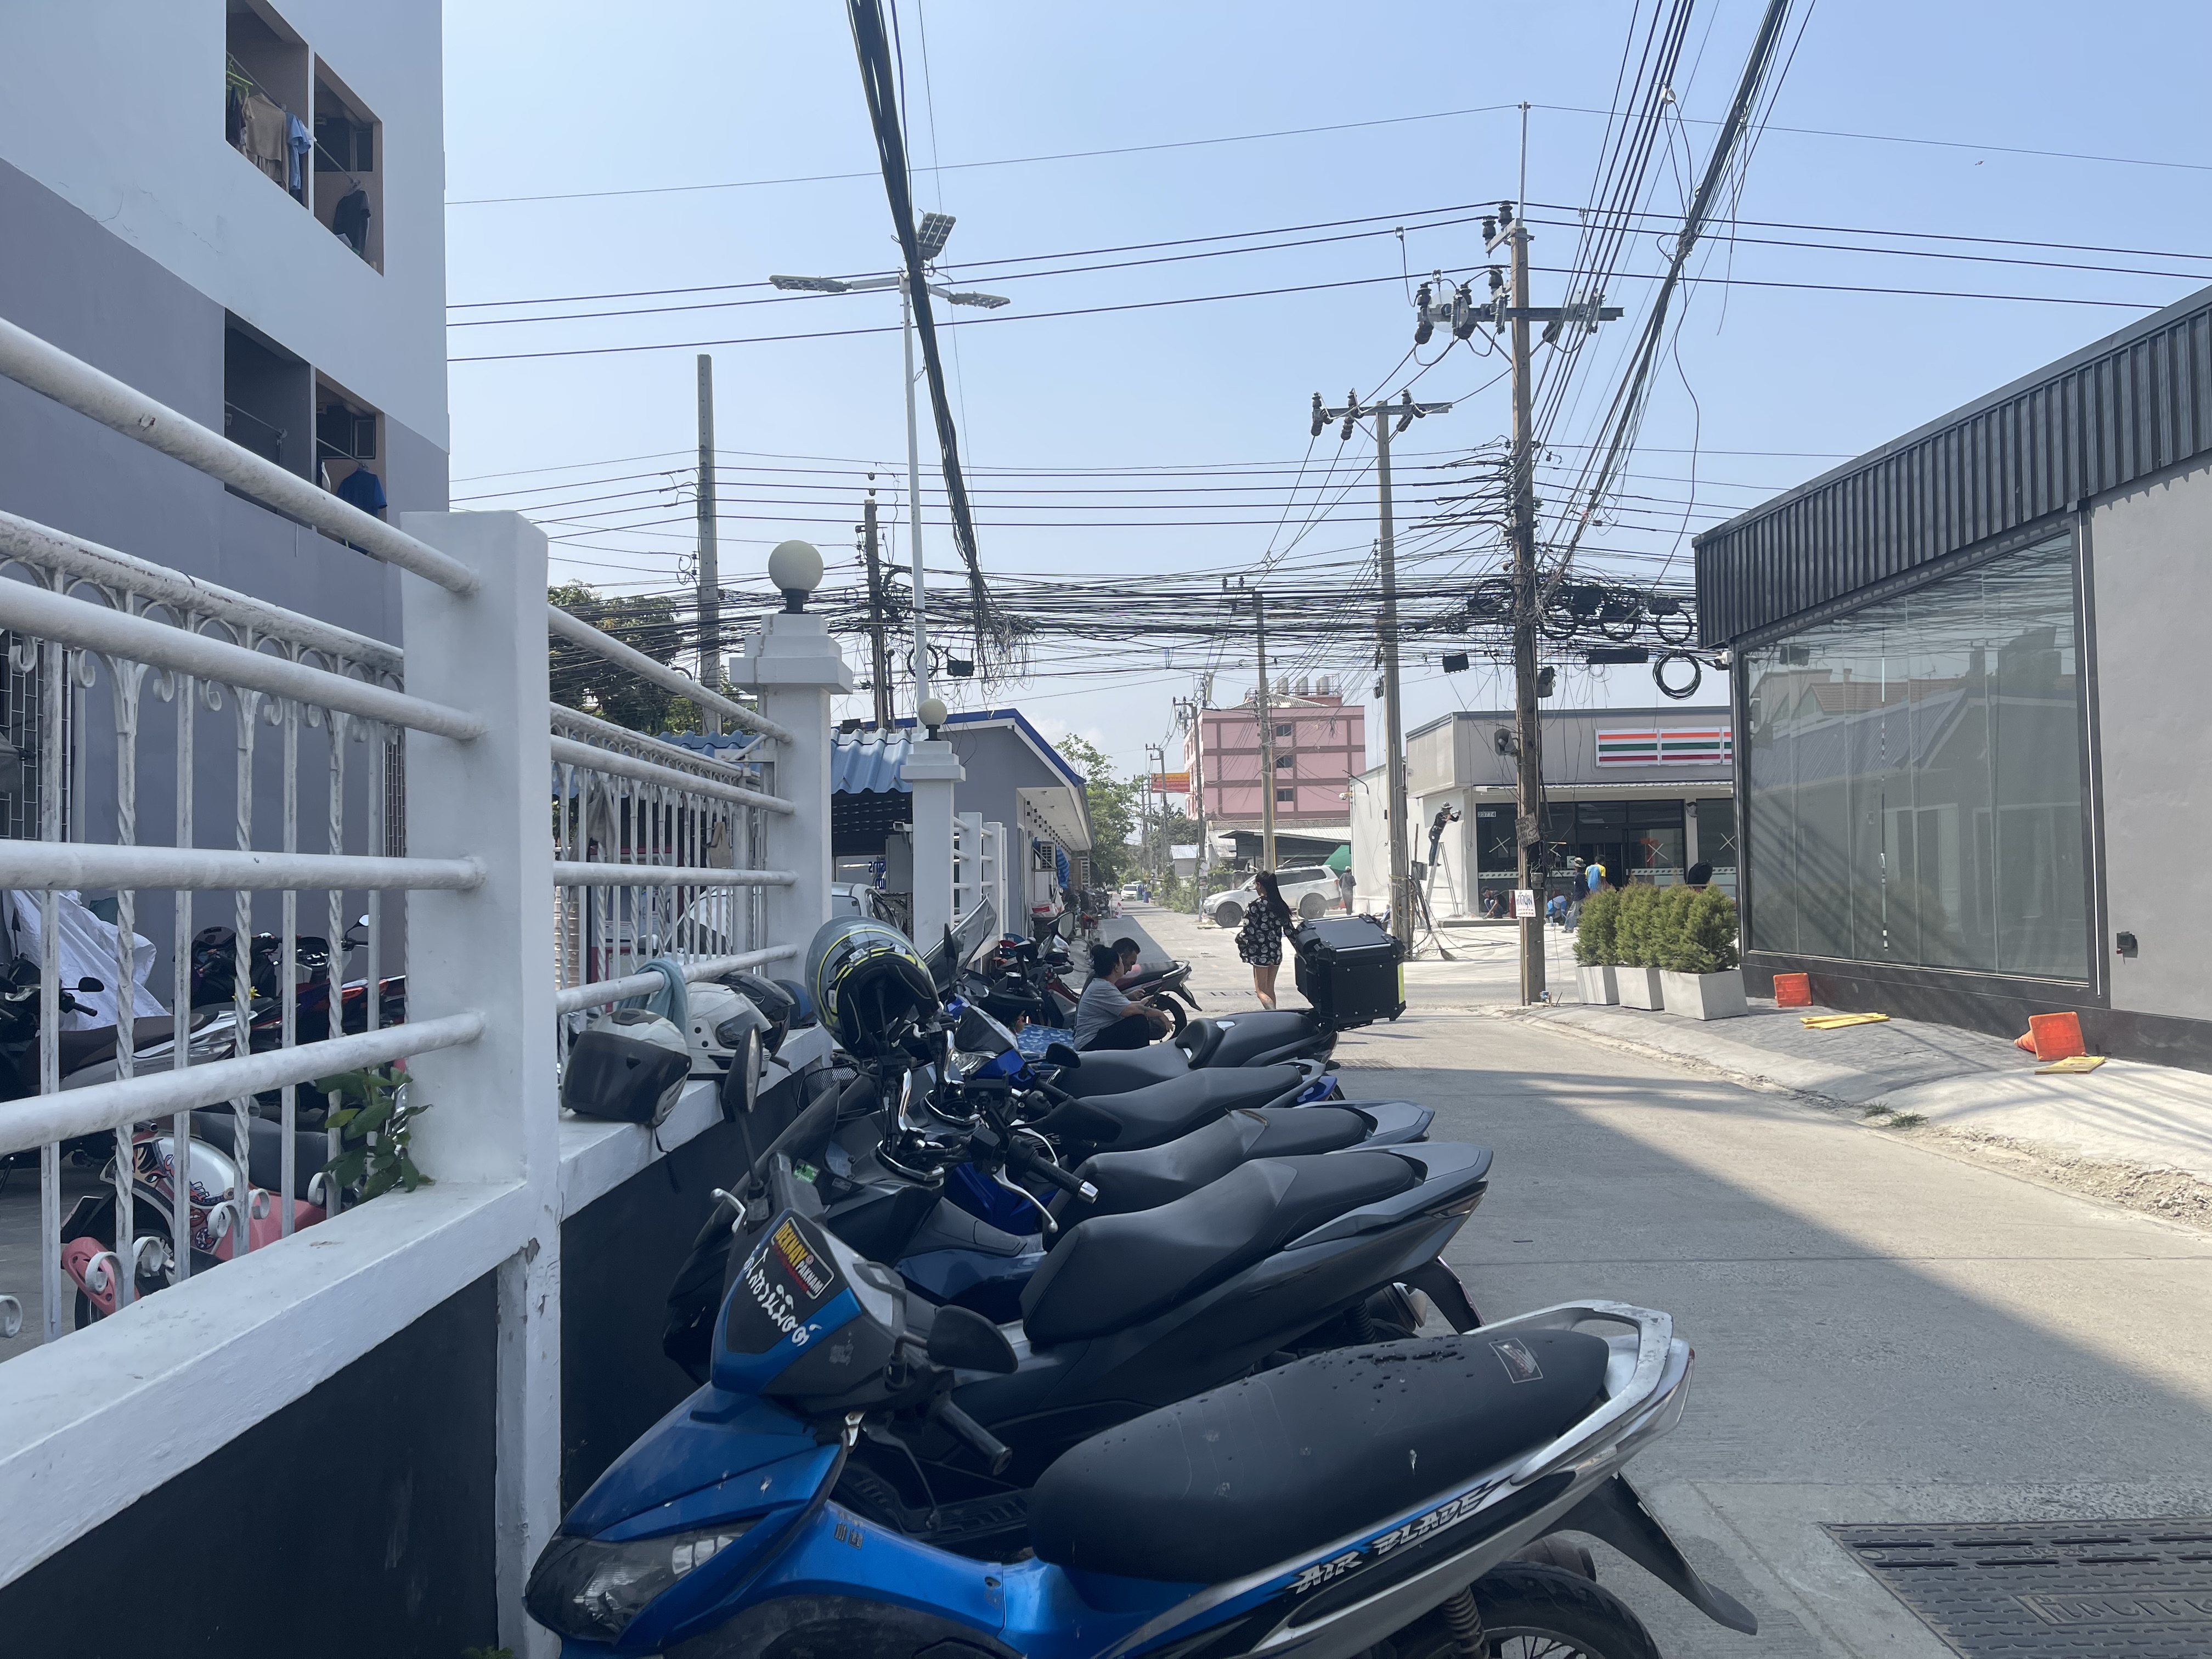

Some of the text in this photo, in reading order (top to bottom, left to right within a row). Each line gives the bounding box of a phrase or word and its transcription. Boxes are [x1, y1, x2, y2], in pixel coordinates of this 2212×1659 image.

[775, 1222, 809, 1268] DEKNAY
[795, 1260, 825, 1294] PAKNAM
[1287, 1478, 1501, 1594] AIR BLADE
